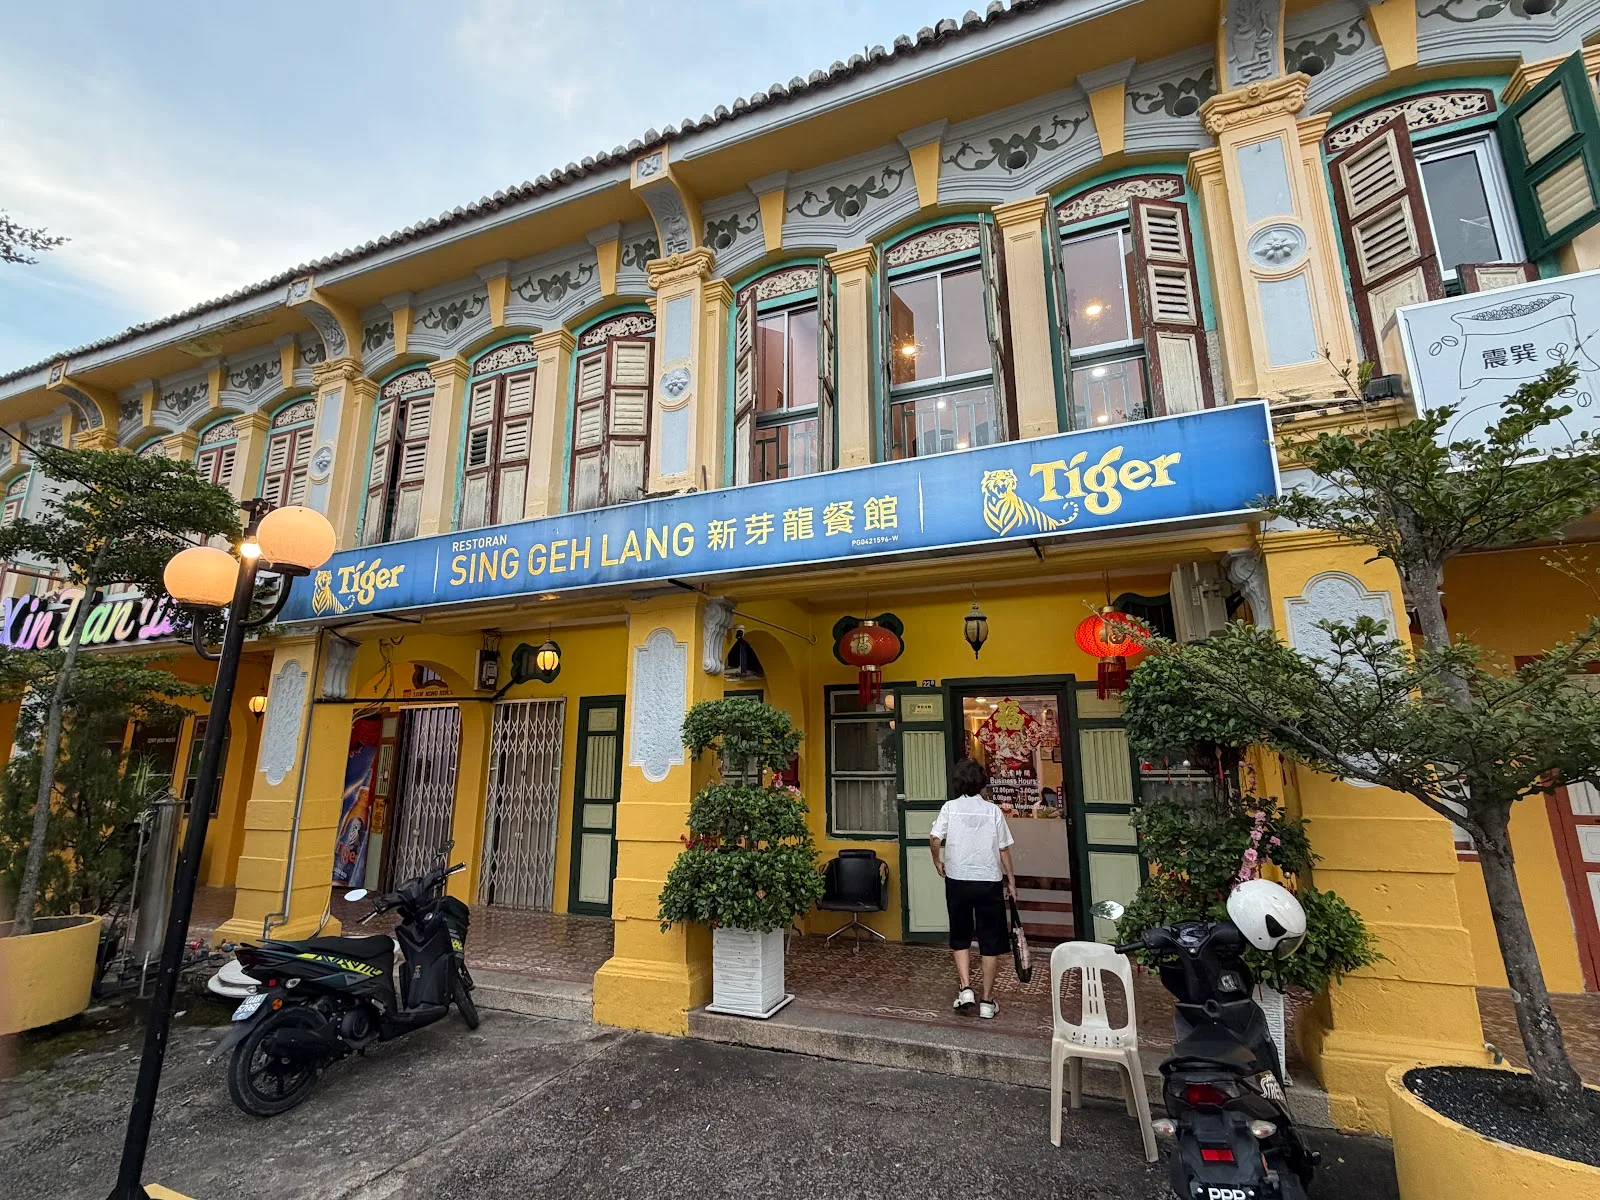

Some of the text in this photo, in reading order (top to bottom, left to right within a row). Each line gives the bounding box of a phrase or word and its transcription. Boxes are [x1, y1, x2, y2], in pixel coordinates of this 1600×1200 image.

[1029, 445, 1182, 516] Tiger
[452, 534, 508, 552] RESTORAN
[707, 495, 898, 551] 新芽龍餐館
[450, 522, 695, 586] SING GEH LANG
[337, 558, 406, 606] Tiger
[990, 776, 1017, 785] Business
